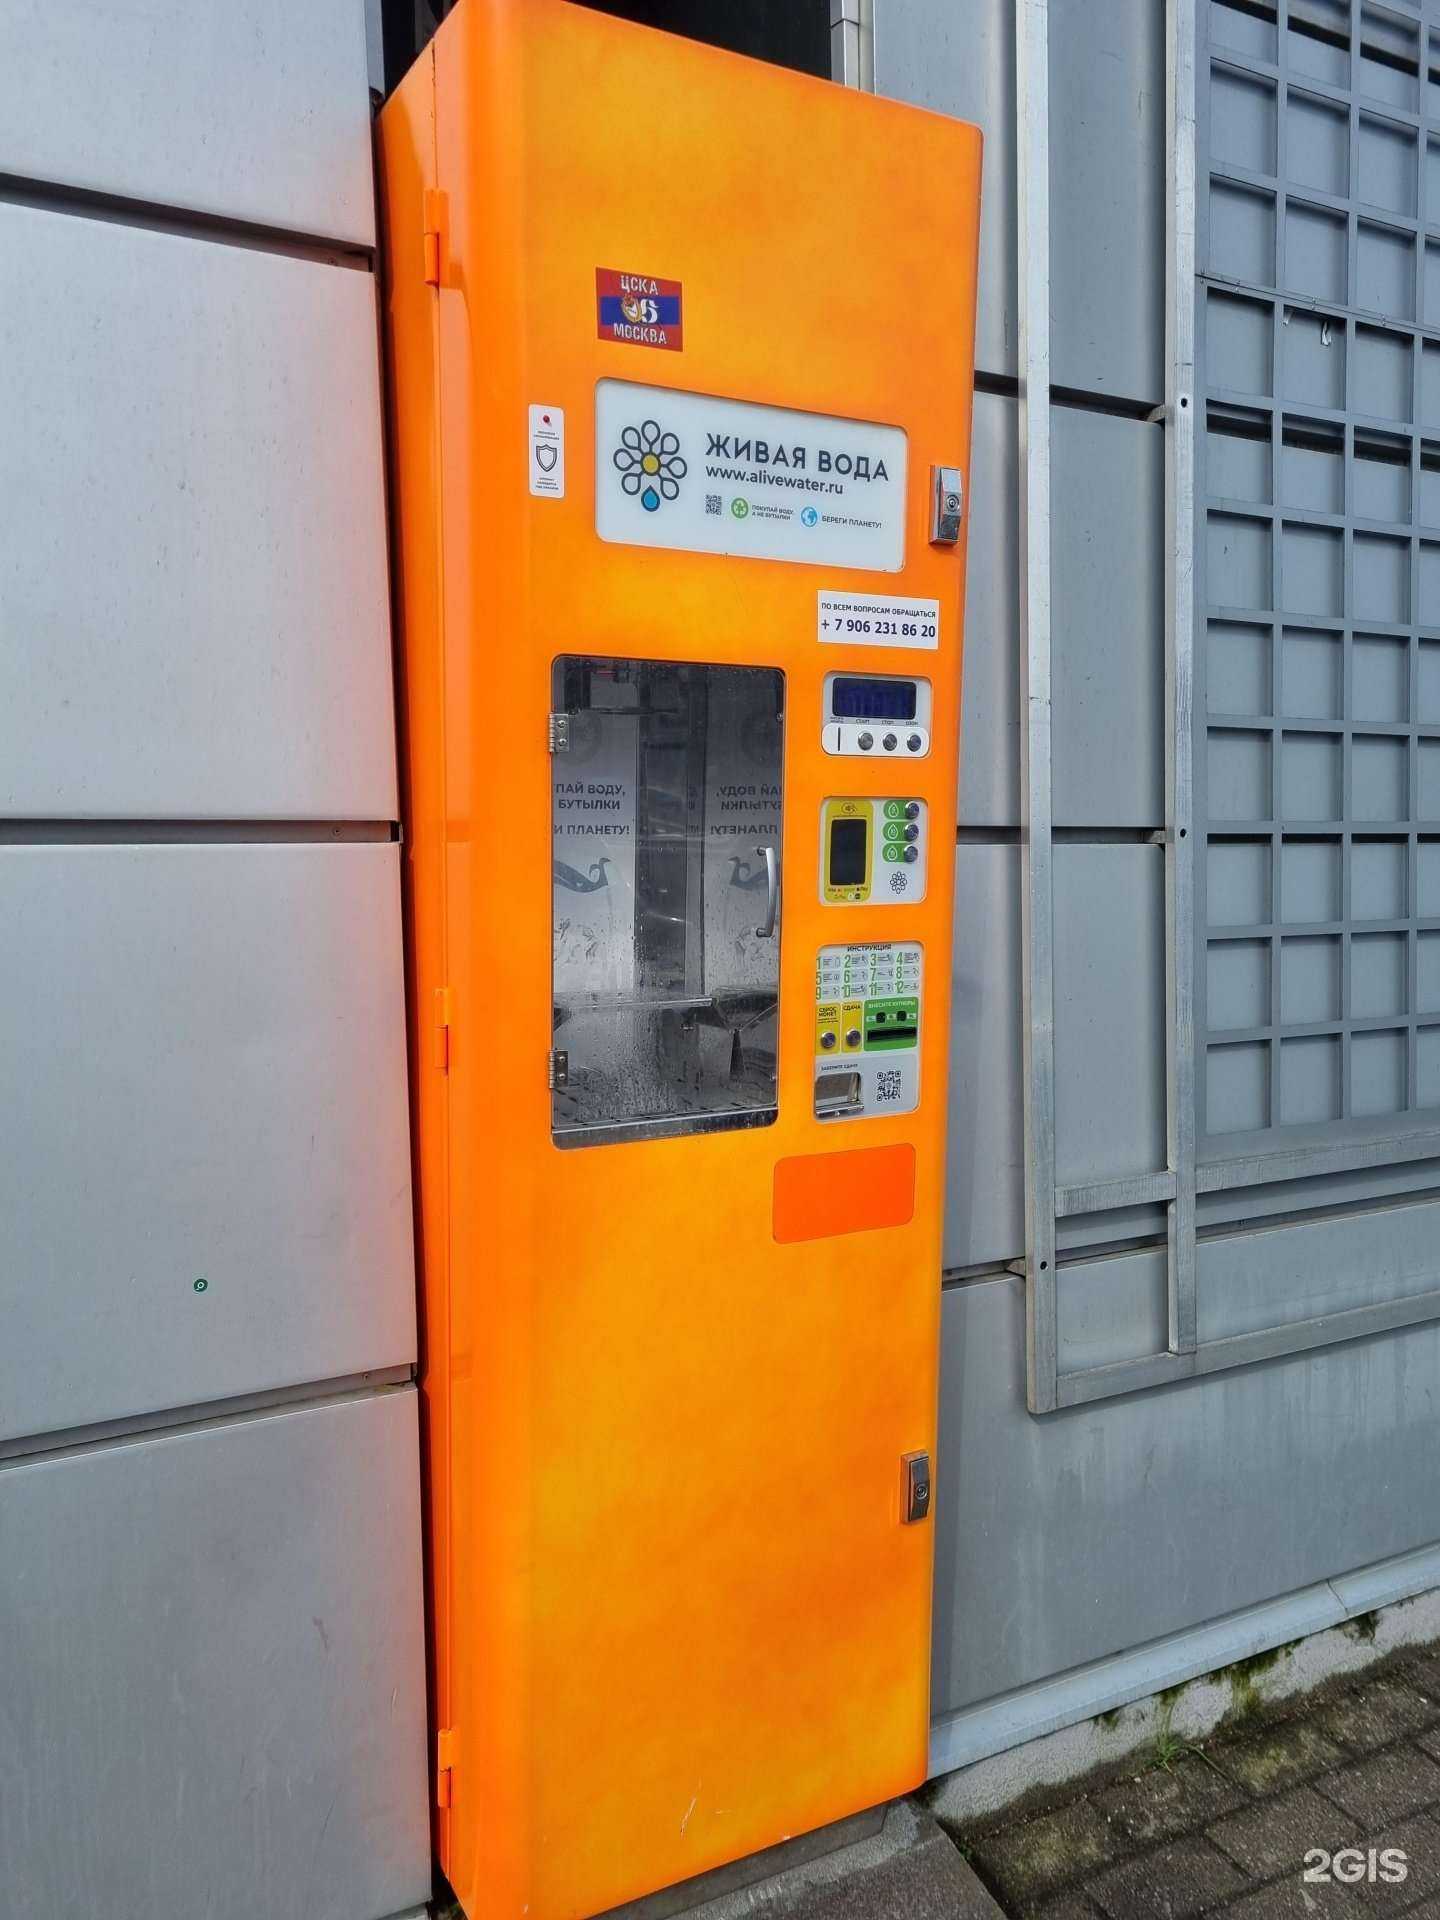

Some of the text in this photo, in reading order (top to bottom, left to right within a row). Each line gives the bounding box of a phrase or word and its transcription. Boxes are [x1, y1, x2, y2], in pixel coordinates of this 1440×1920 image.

[620, 275, 659, 295] ЦСКА
[613, 323, 667, 345] МОСКВА
[705, 432, 889, 483] ЖИВАЯ ВОДА
[705, 465, 844, 495] www.alivewater.ru
[751, 504, 778, 513] ПОКУПАЙ
[822, 515, 882, 529] БЕРЕГИ ПЛАНЕТУ!
[833, 603, 852, 611] ВСЕМ
[853, 605, 891, 614] ВОПРОСАМ
[891, 608, 936, 618] ОБРАЩАТЬСЯ
[835, 618, 843, 631] 7
[847, 619, 871, 633] 906
[874, 621, 898, 635] 231
[901, 623, 917, 636] 86
[921, 624, 936, 638] 20
[587, 784, 626, 797] ВОДУ,
[558, 799, 621, 810] БУТЫЛКИ
[567, 825, 630, 835] ПЛАНЕТУ!
[847, 943, 892, 952] ИНСТРУКЦИЯ
[844, 954, 851, 968] 2
[870, 953, 877, 966] 3
[895, 952, 903, 965] 4
[844, 969, 851, 983] 6
[870, 967, 877, 981] 7
[896, 966, 903, 979] 8
[842, 984, 851, 998] 10
[869, 982, 877, 996] 11
[895, 980, 904, 994] 12
[843, 1004, 861, 1012] СДАЧА
